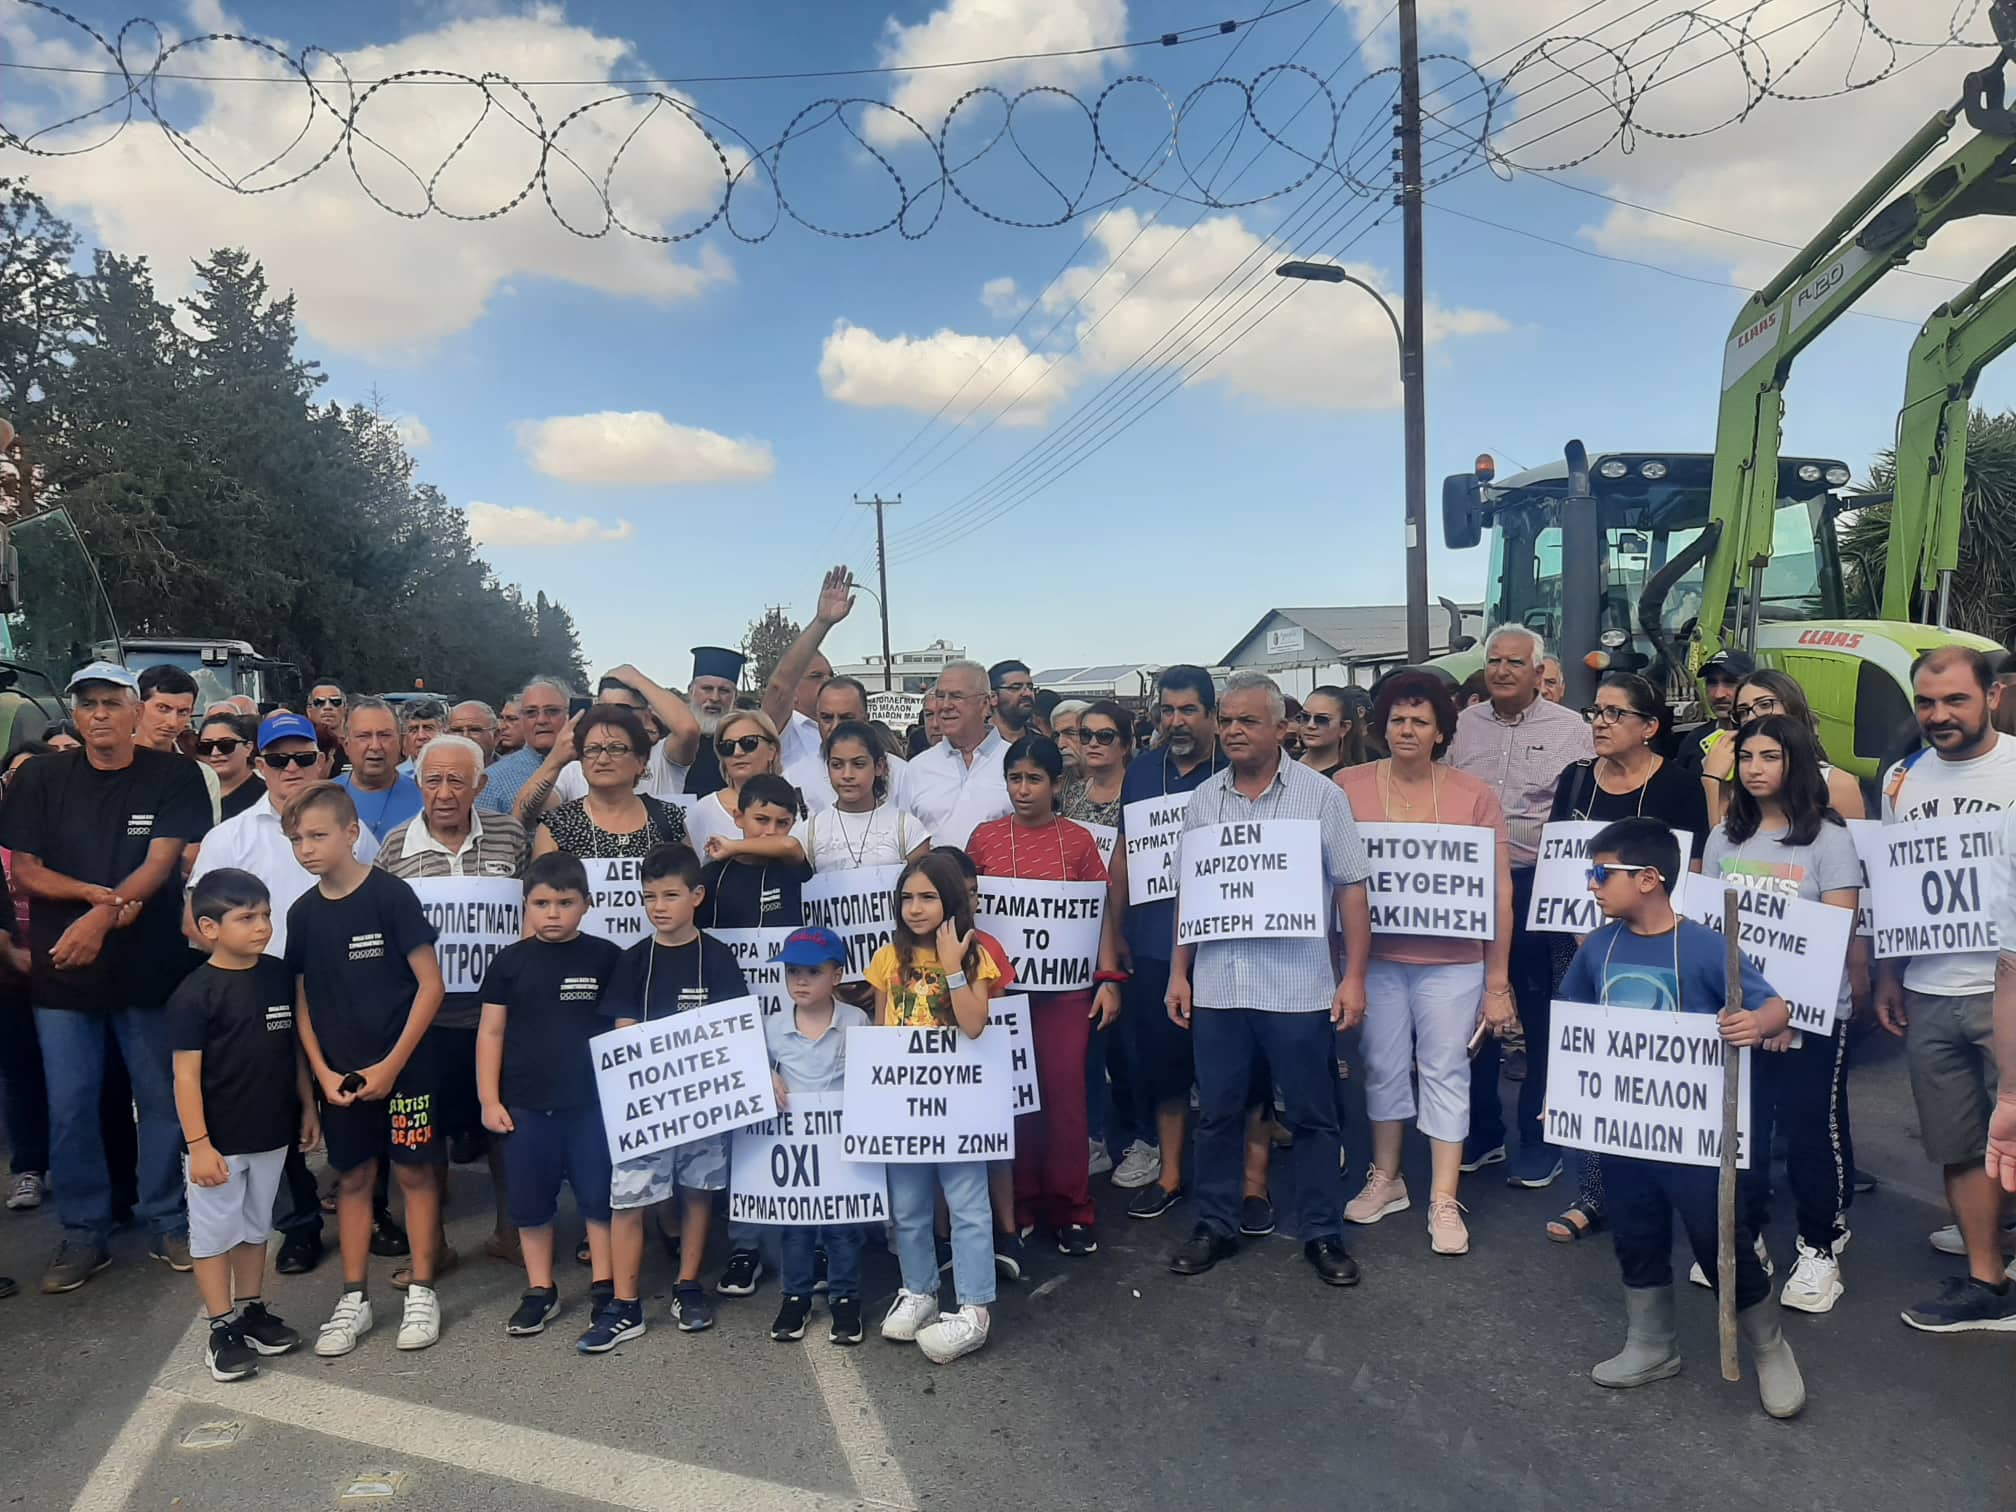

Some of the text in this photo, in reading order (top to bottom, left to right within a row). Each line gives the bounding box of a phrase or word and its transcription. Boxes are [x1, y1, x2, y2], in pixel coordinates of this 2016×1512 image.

[1738, 313, 1777, 348] CLAAS
[1798, 630, 1864, 648] CLAAS
[1220, 824, 1262, 847] ΔΕΝ
[1195, 853, 1288, 877] ΧΑΡΙΖΟΥΜΕ
[1361, 838, 1479, 863] ΗΤΟΥΜΕ
[1889, 836, 1948, 867] ΧΤΙΣΤΕ
[1220, 881, 1254, 900] ΤΗΝ
[1738, 889, 1786, 920] ΔΕΝ
[1922, 867, 1981, 915] ΟΧΙ
[801, 890, 898, 928] ΡΜΑΤΟΠΛΕΓΜ
[605, 917, 641, 934] ΤΗΝ
[1023, 928, 1050, 950] ΤΟ
[1180, 914, 1316, 938] ΟΥΔΕΤΕΡΗ ΖΩΝΗ
[601, 1013, 755, 1071] ΔΕΝ ΕΙΜΑΣΤΕ
[907, 1029, 958, 1053] ΔΕΝ
[1560, 1025, 1595, 1054] ΔΕΝ
[628, 1046, 731, 1090] ΠΟΛΙΤΕΣ
[871, 1065, 983, 1085] ΧΑΡΙΖΟΥΜΕ
[625, 1070, 746, 1121] ΔΕΥΤΕΡΗΣ
[1577, 1070, 1708, 1111] ΤΟ ΜΕΛΛΟΝ
[906, 1097, 947, 1116] ΤΗΝ
[618, 1094, 764, 1152] ΚΑΤΗΓΟΡΙΑΣ
[1548, 1108, 1744, 1159] ΤΩΝ ΠΑΙΔΙΩΝ ΜΣ
[844, 1133, 1008, 1155] ΟΥΔΕΤΕΡΗ ΖΩΝΗ
[771, 1143, 821, 1187] ΟΧΙ
[732, 1192, 885, 1221] ΣΥΡΜΑΤΟΠΛΕΓΜΤΑ
